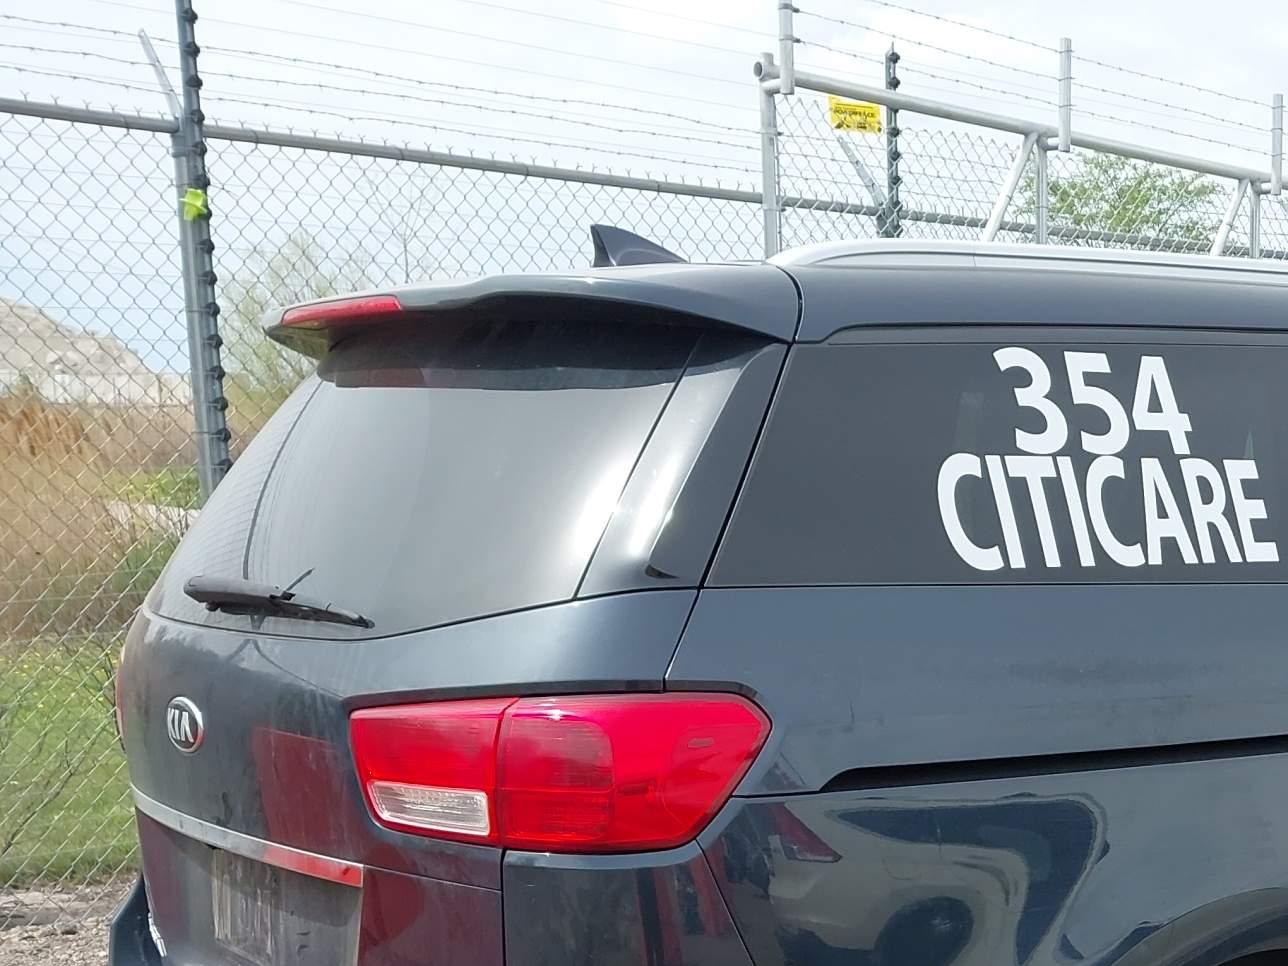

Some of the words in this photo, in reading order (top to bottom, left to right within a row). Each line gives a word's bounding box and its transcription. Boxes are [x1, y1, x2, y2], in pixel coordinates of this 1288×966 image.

[993, 347, 1193, 455] 354
[937, 453, 1280, 571] CITICARE
[167, 707, 195, 743] KIA
